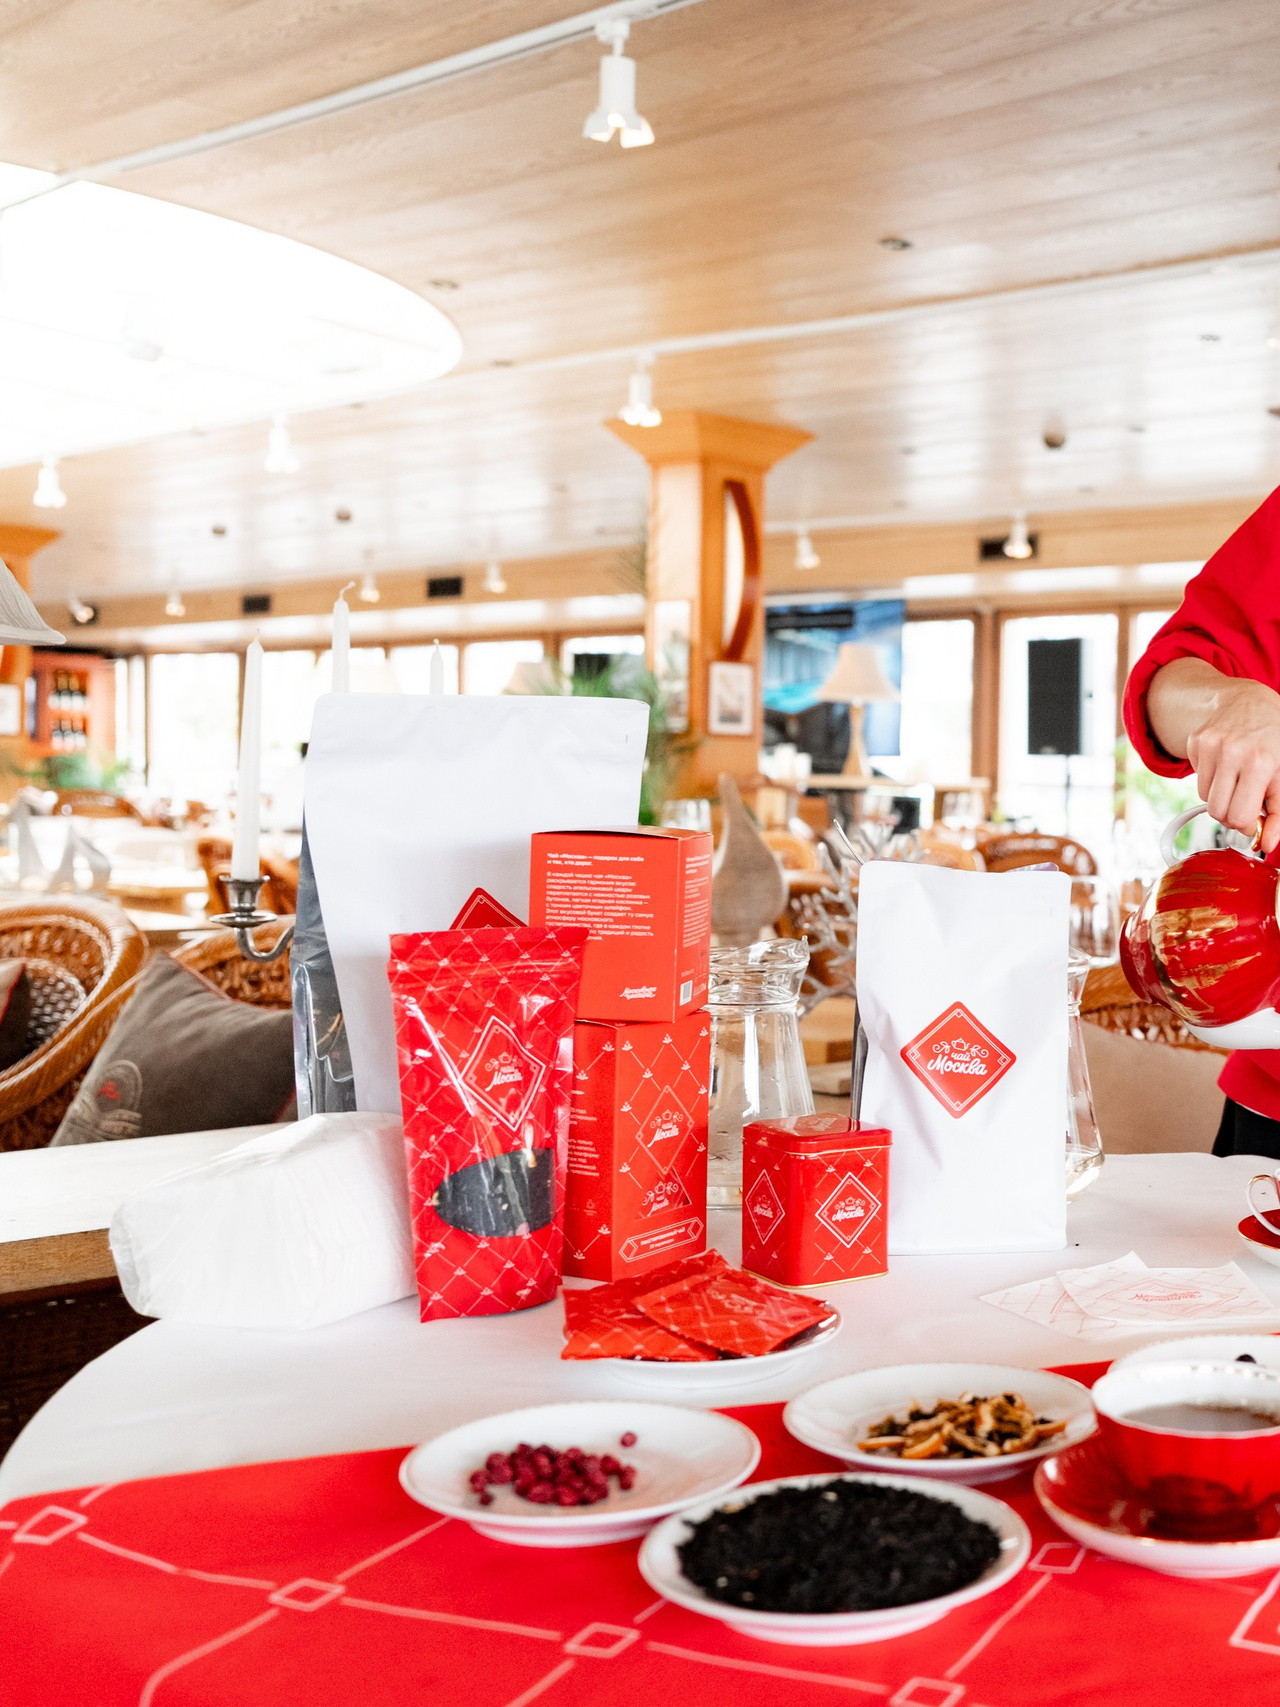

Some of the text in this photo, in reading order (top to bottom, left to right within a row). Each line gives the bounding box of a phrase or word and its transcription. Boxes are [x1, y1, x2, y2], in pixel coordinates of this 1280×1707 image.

[950, 1051, 971, 1061] чай
[927, 1054, 988, 1075] Москва
[831, 1206, 865, 1222] Москва
